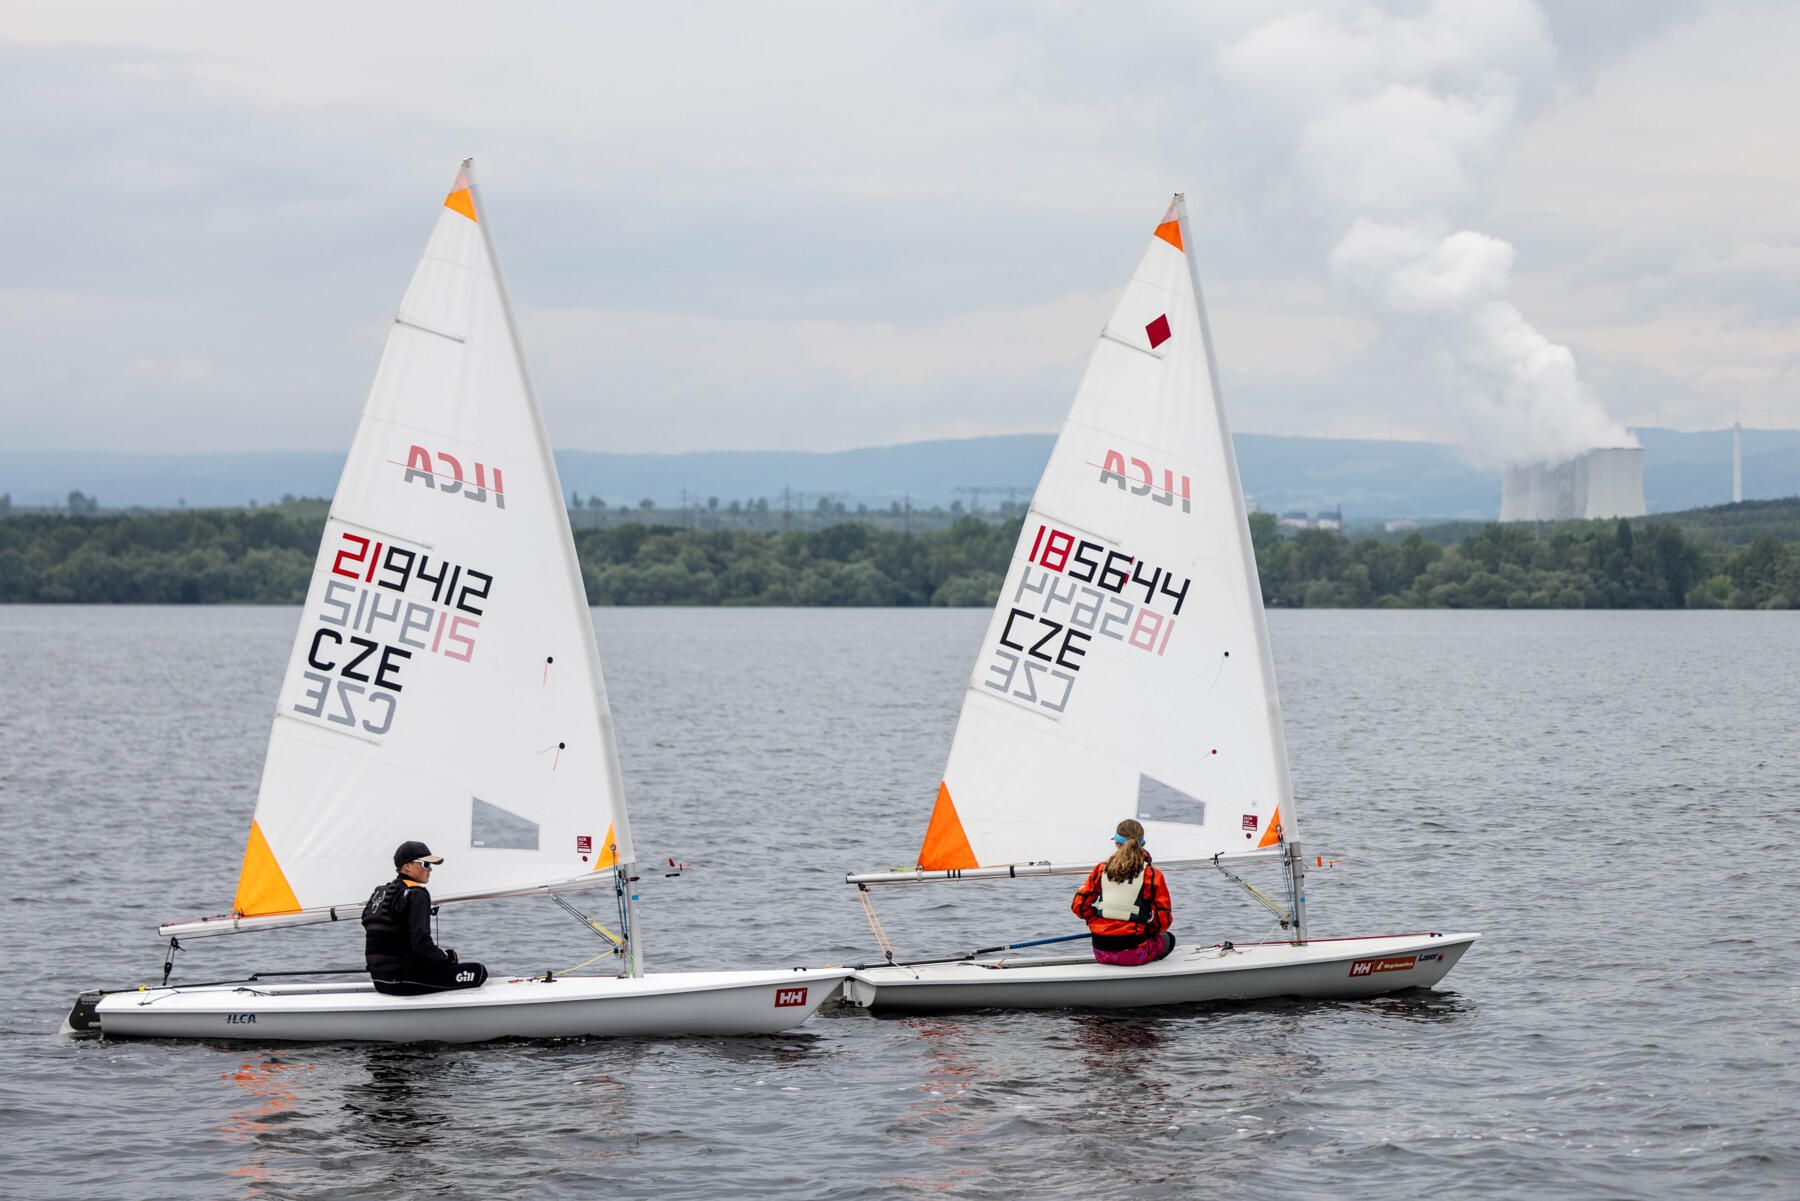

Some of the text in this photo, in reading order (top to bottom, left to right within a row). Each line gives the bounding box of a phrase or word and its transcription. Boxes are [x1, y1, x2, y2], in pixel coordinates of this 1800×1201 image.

[332, 532, 493, 616] 219412
[1028, 525, 1191, 616] 185644
[999, 607, 1092, 671] CZE
[308, 628, 412, 692] CZE
[455, 970, 475, 983] Gill
[1352, 962, 1372, 975] HH
[780, 991, 803, 1004] HH
[226, 1014, 257, 1024] ILCA
